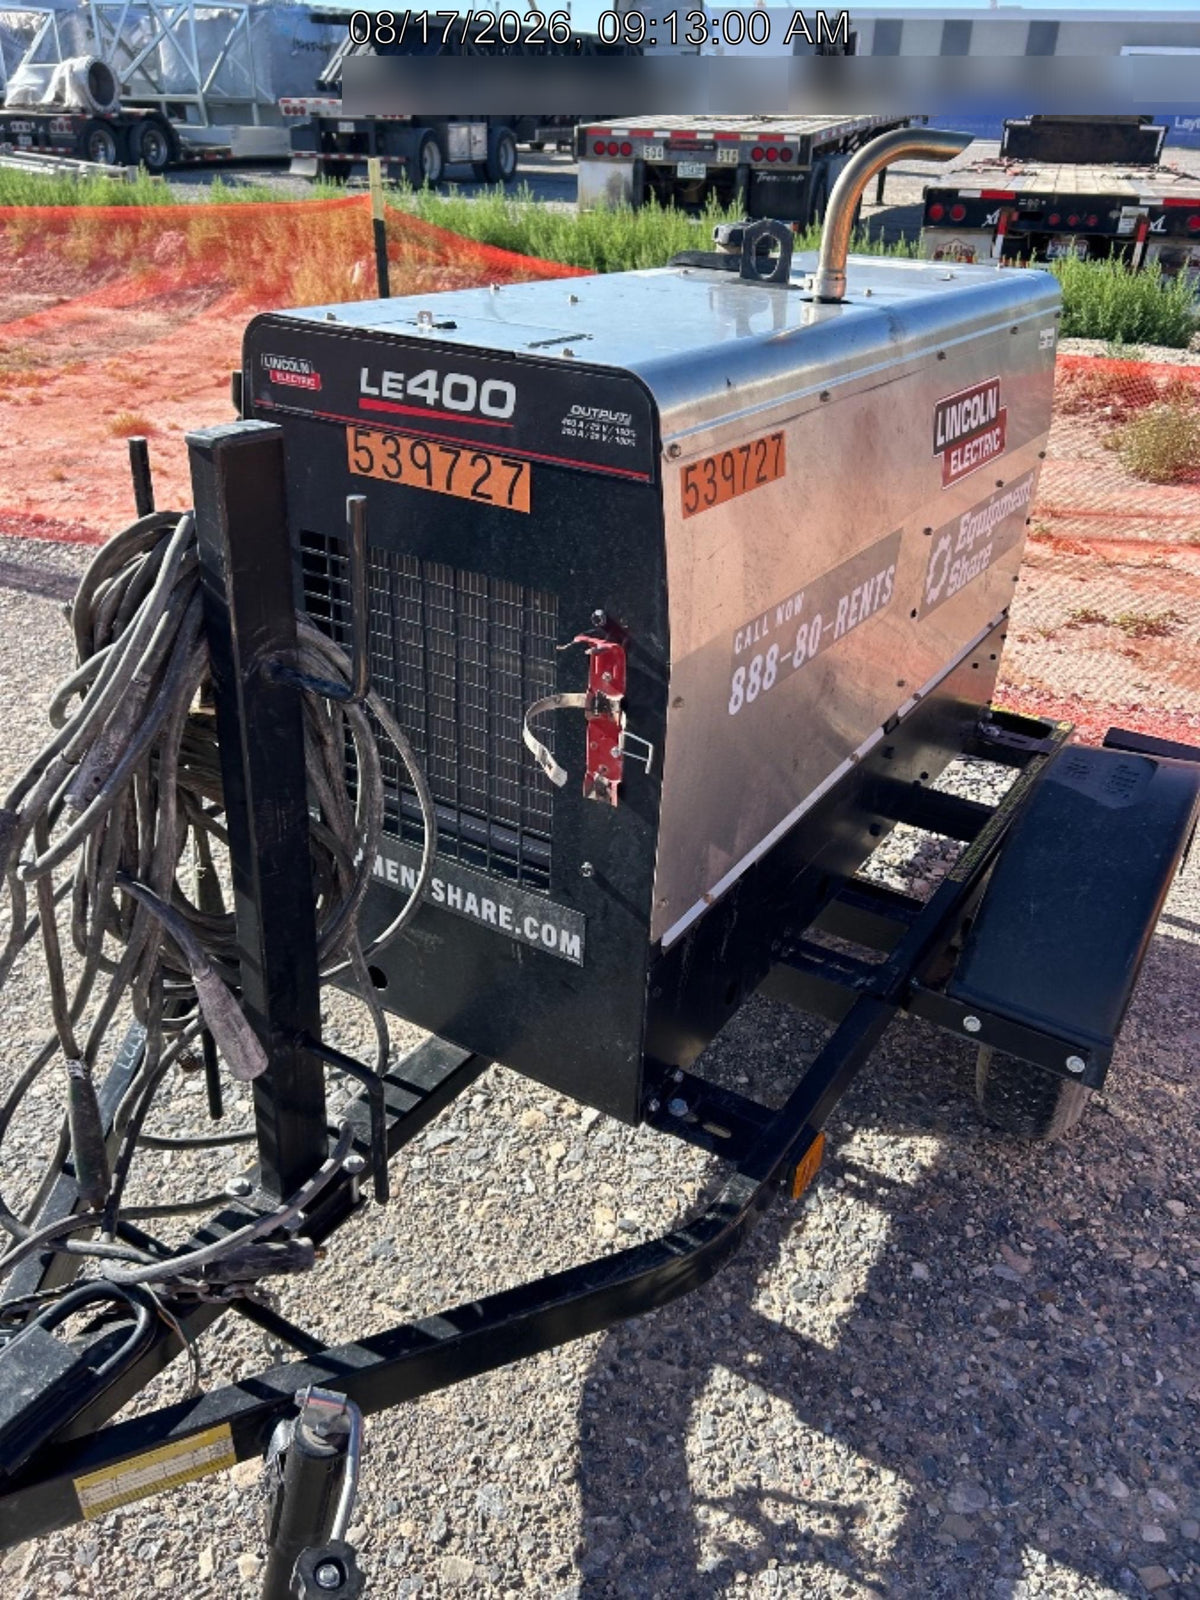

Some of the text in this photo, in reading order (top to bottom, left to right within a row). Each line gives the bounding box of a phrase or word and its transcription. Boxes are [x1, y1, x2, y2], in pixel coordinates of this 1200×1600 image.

[264, 355, 310, 374] LINCOLN
[276, 373, 316, 386] ELECTRIC
[359, 366, 517, 419] LE400
[570, 404, 629, 423] OUTPUT
[936, 386, 998, 447] LINCOLN
[354, 429, 524, 506] 539727
[685, 432, 784, 514] 539727
[950, 427, 1001, 476] ELECTRIC
[954, 471, 1035, 553] Equipment
[947, 541, 993, 597] Share
[728, 563, 895, 716] 888-80-RENTS
[735, 591, 805, 655] CALL NOW
